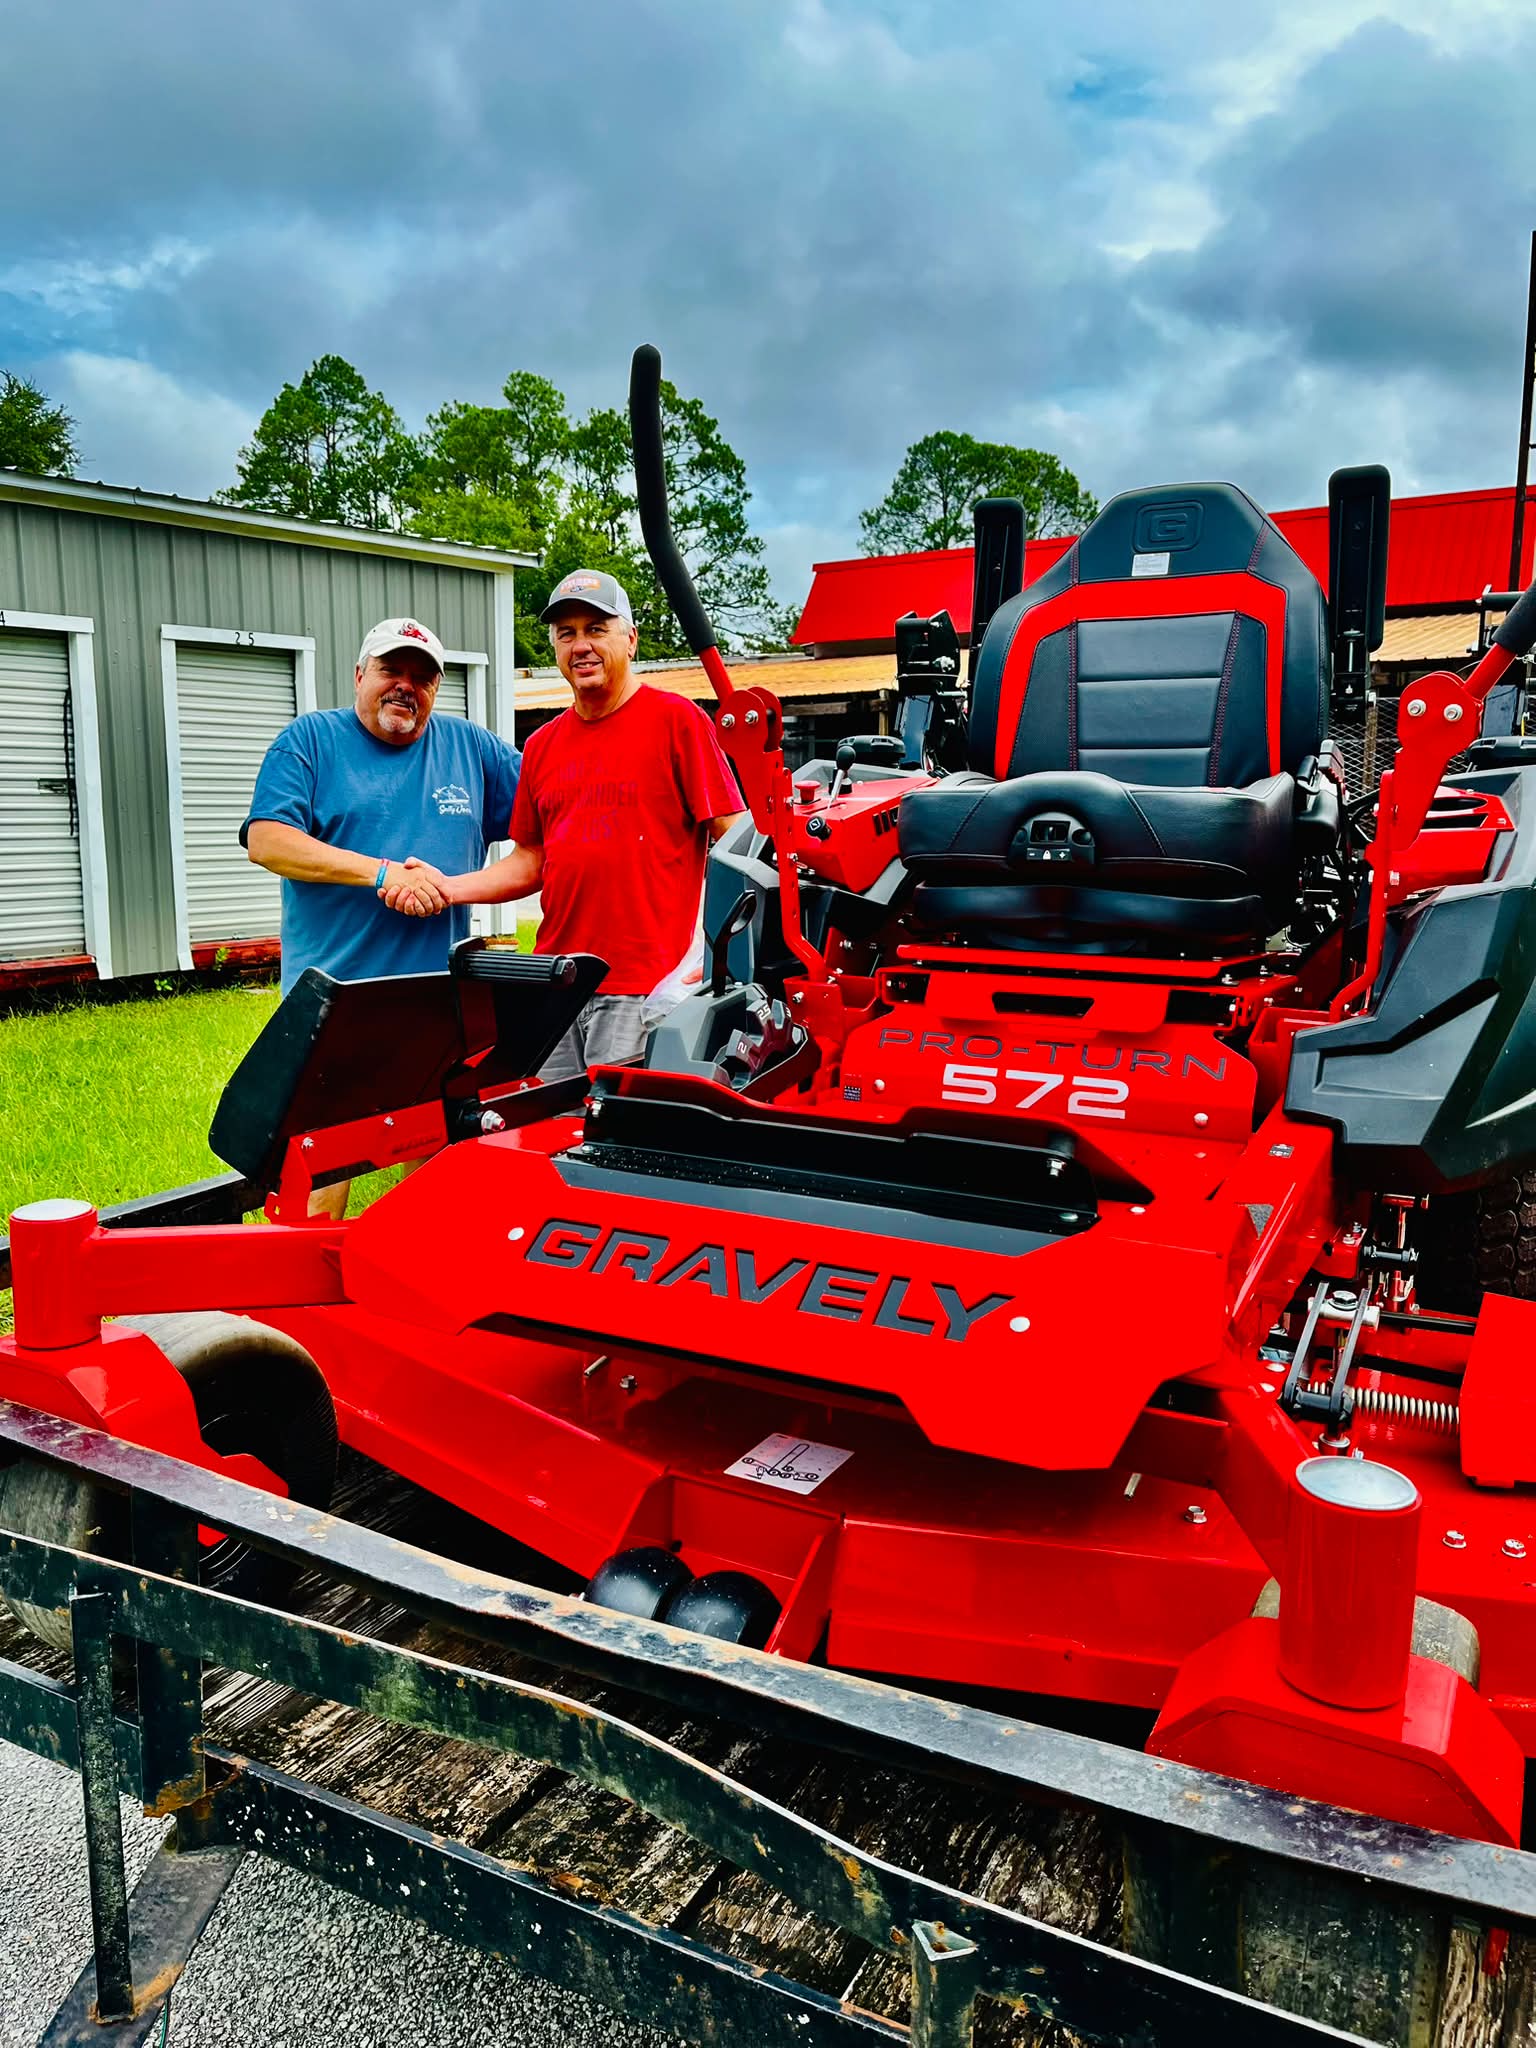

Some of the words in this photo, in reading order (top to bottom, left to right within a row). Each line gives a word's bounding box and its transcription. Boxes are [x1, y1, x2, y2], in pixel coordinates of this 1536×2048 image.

[737, 1041, 747, 1054] 2
[879, 1028, 1226, 1081] PRO-TURN
[941, 1063, 1130, 1119] 572
[525, 1217, 1016, 1342] GRAVELY
